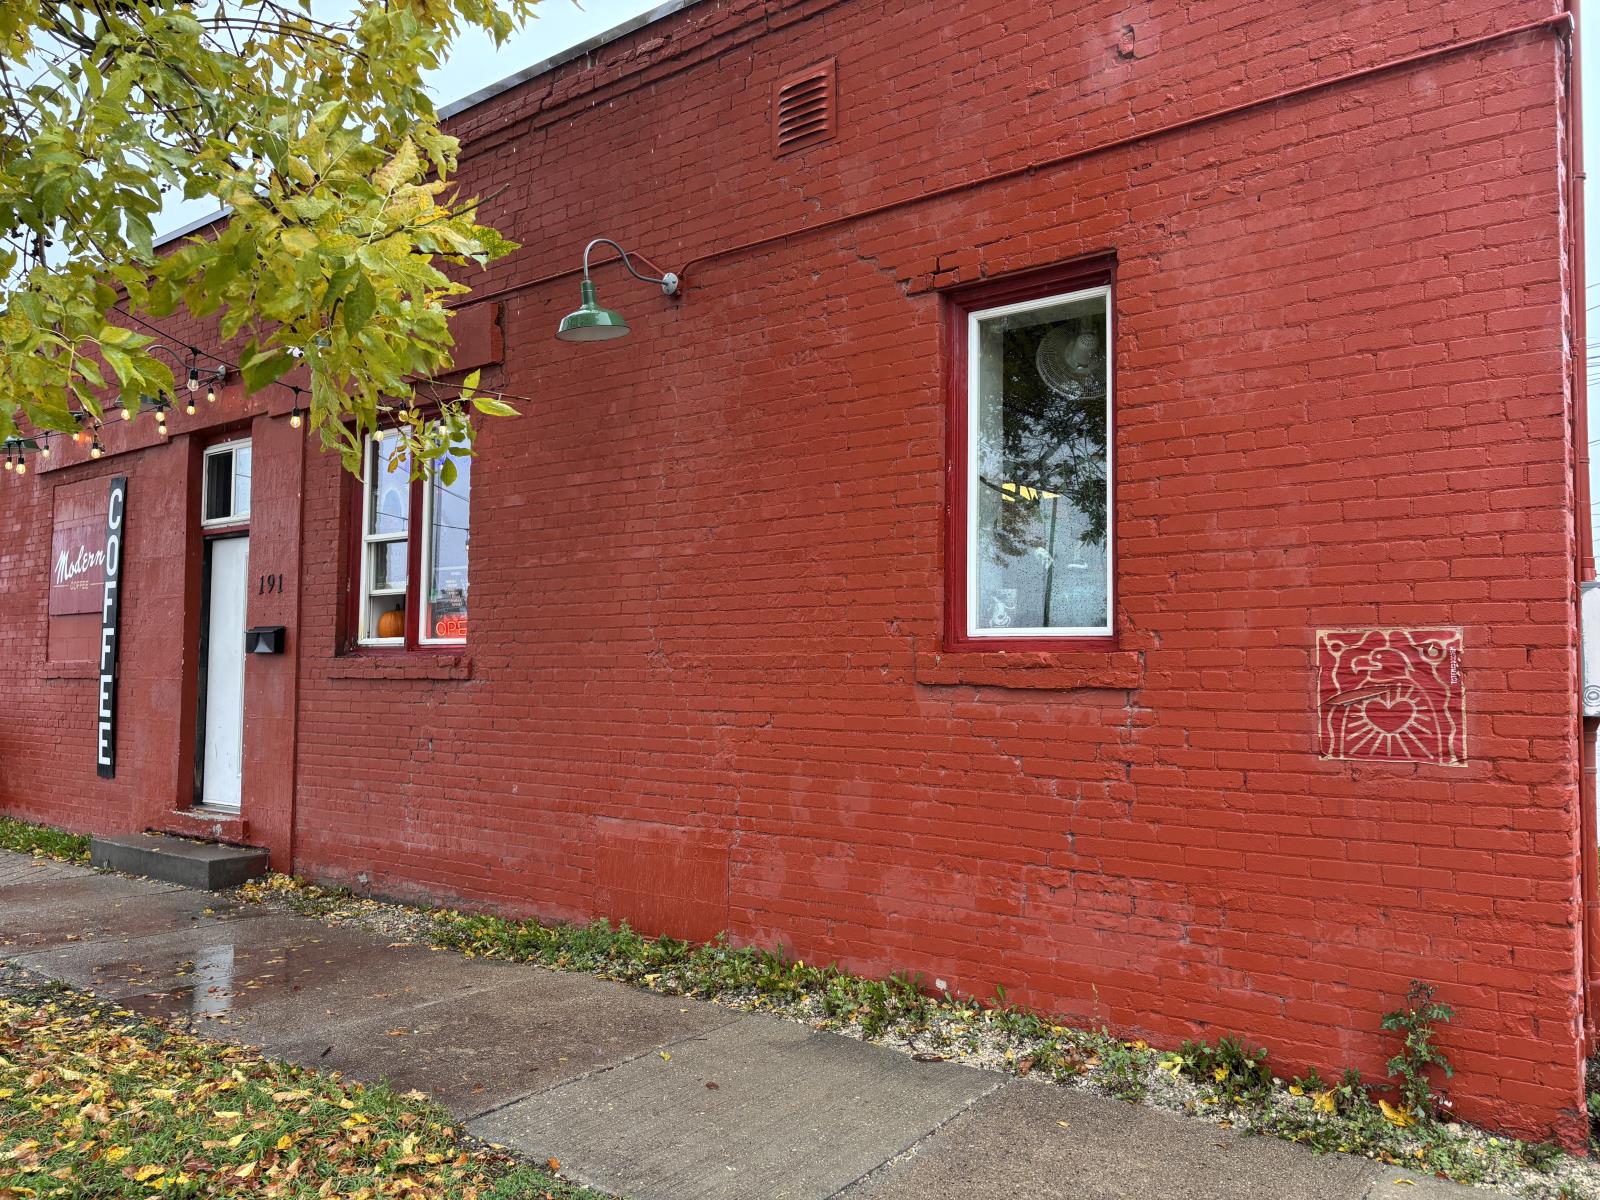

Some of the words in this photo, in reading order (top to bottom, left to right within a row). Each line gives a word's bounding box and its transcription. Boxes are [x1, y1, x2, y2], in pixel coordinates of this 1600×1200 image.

[54, 544, 106, 585] Modern
[69, 580, 89, 591] COFFEE
[259, 573, 283, 595] 191
[98, 487, 123, 766] COFFEE
